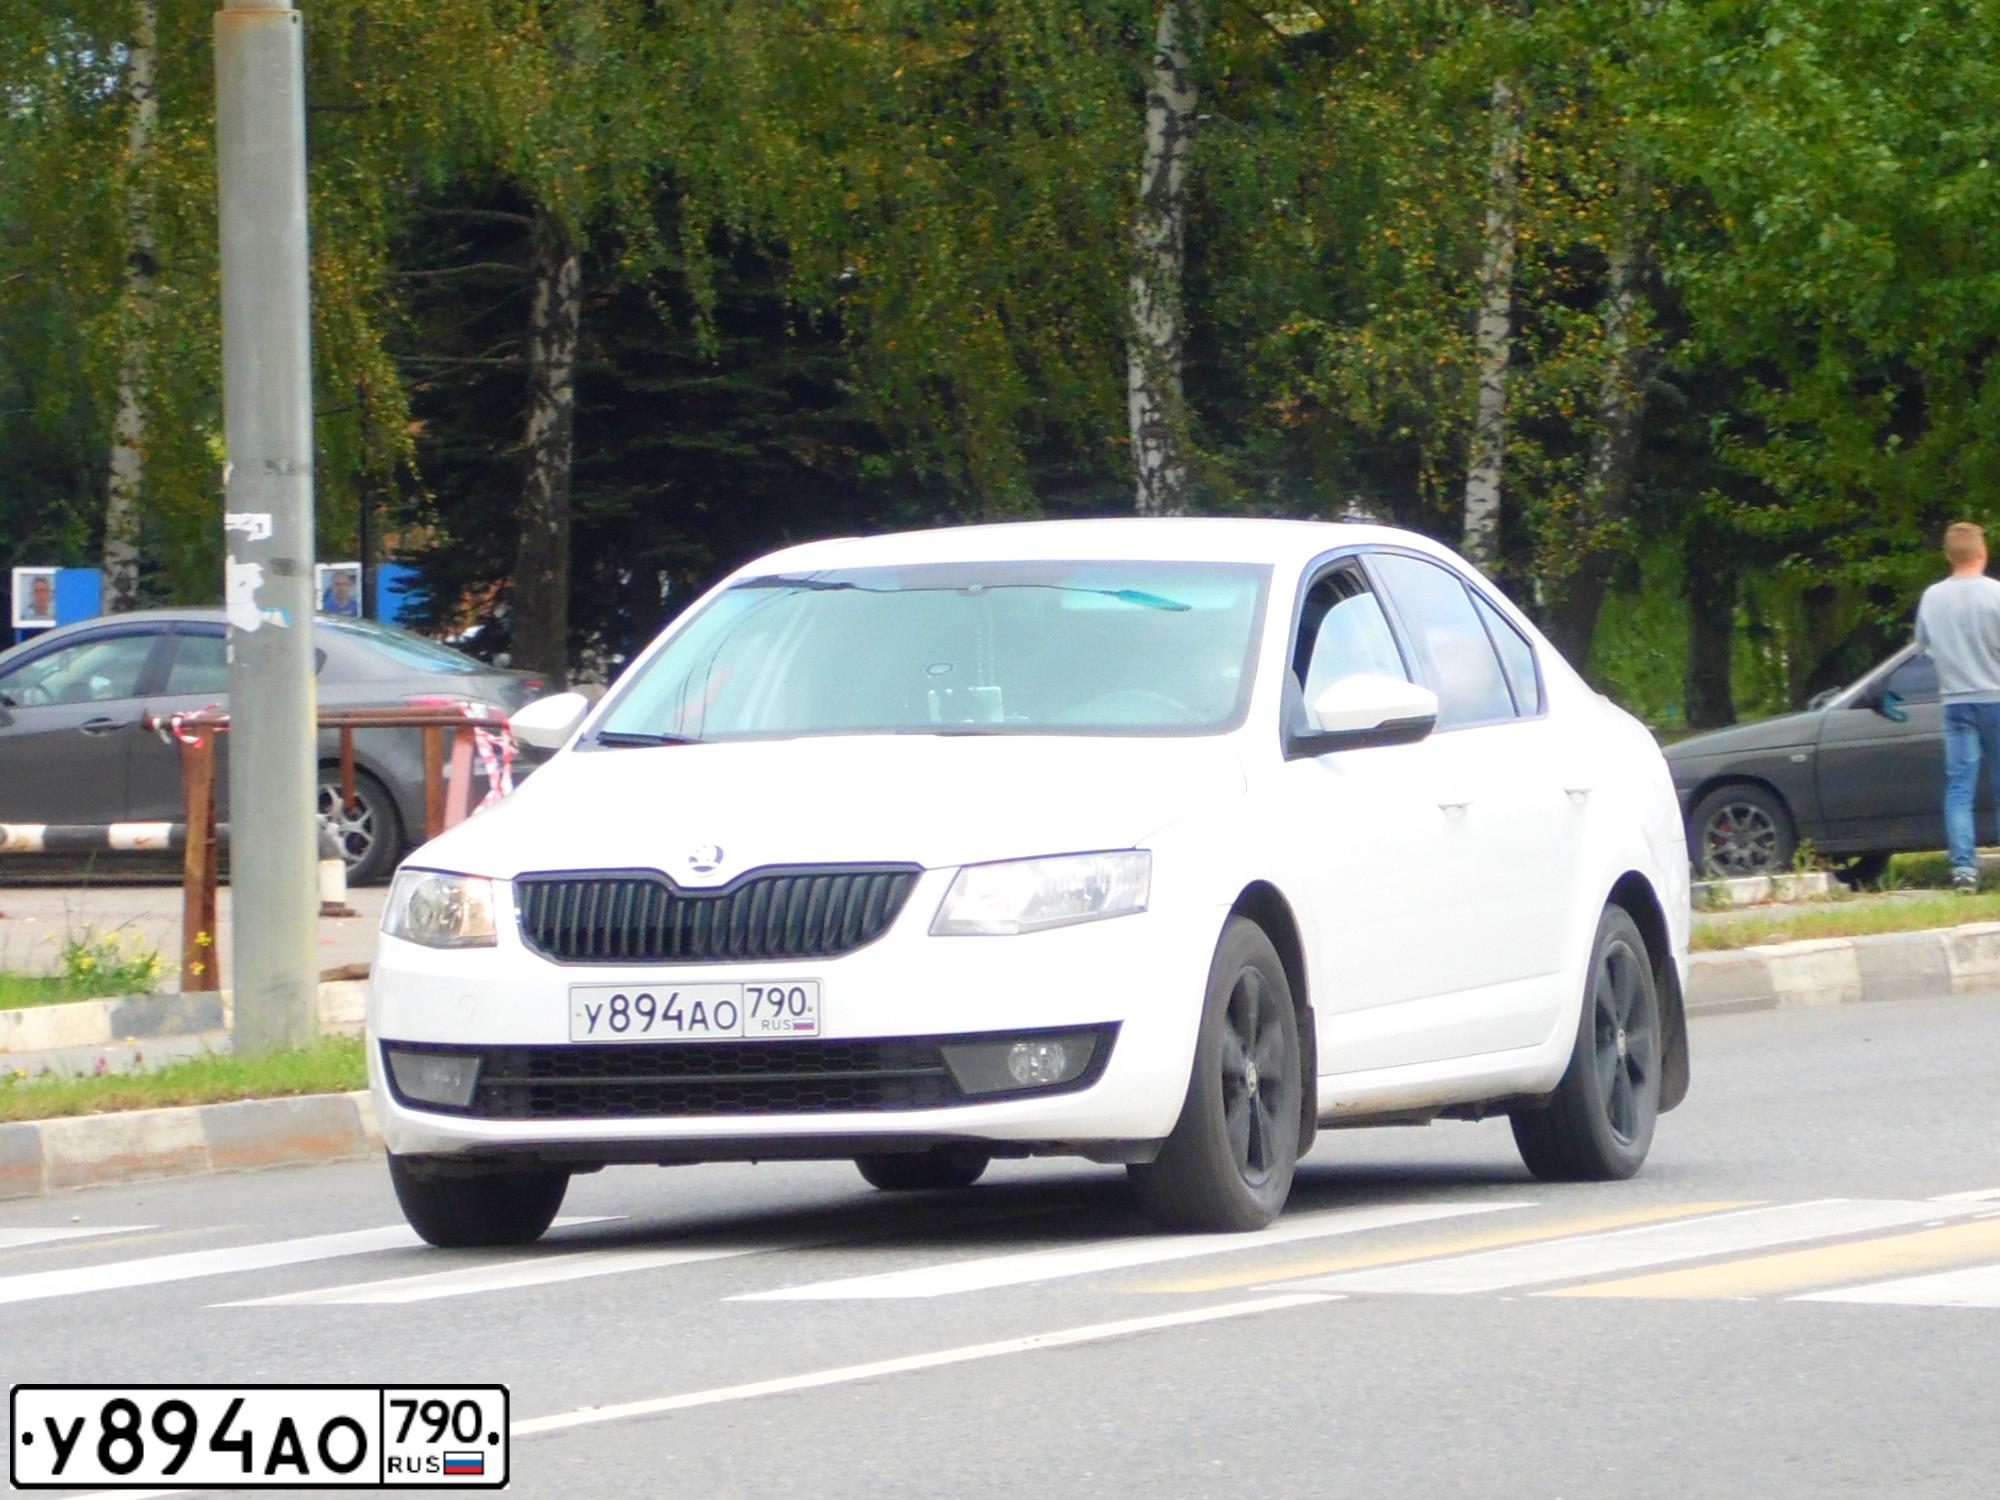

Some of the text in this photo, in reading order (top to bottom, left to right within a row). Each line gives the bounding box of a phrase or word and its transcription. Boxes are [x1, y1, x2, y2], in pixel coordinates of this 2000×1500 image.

[584, 992, 738, 1034] У894АО
[746, 986, 807, 1018] 790
[761, 1019, 791, 1031] RUS
